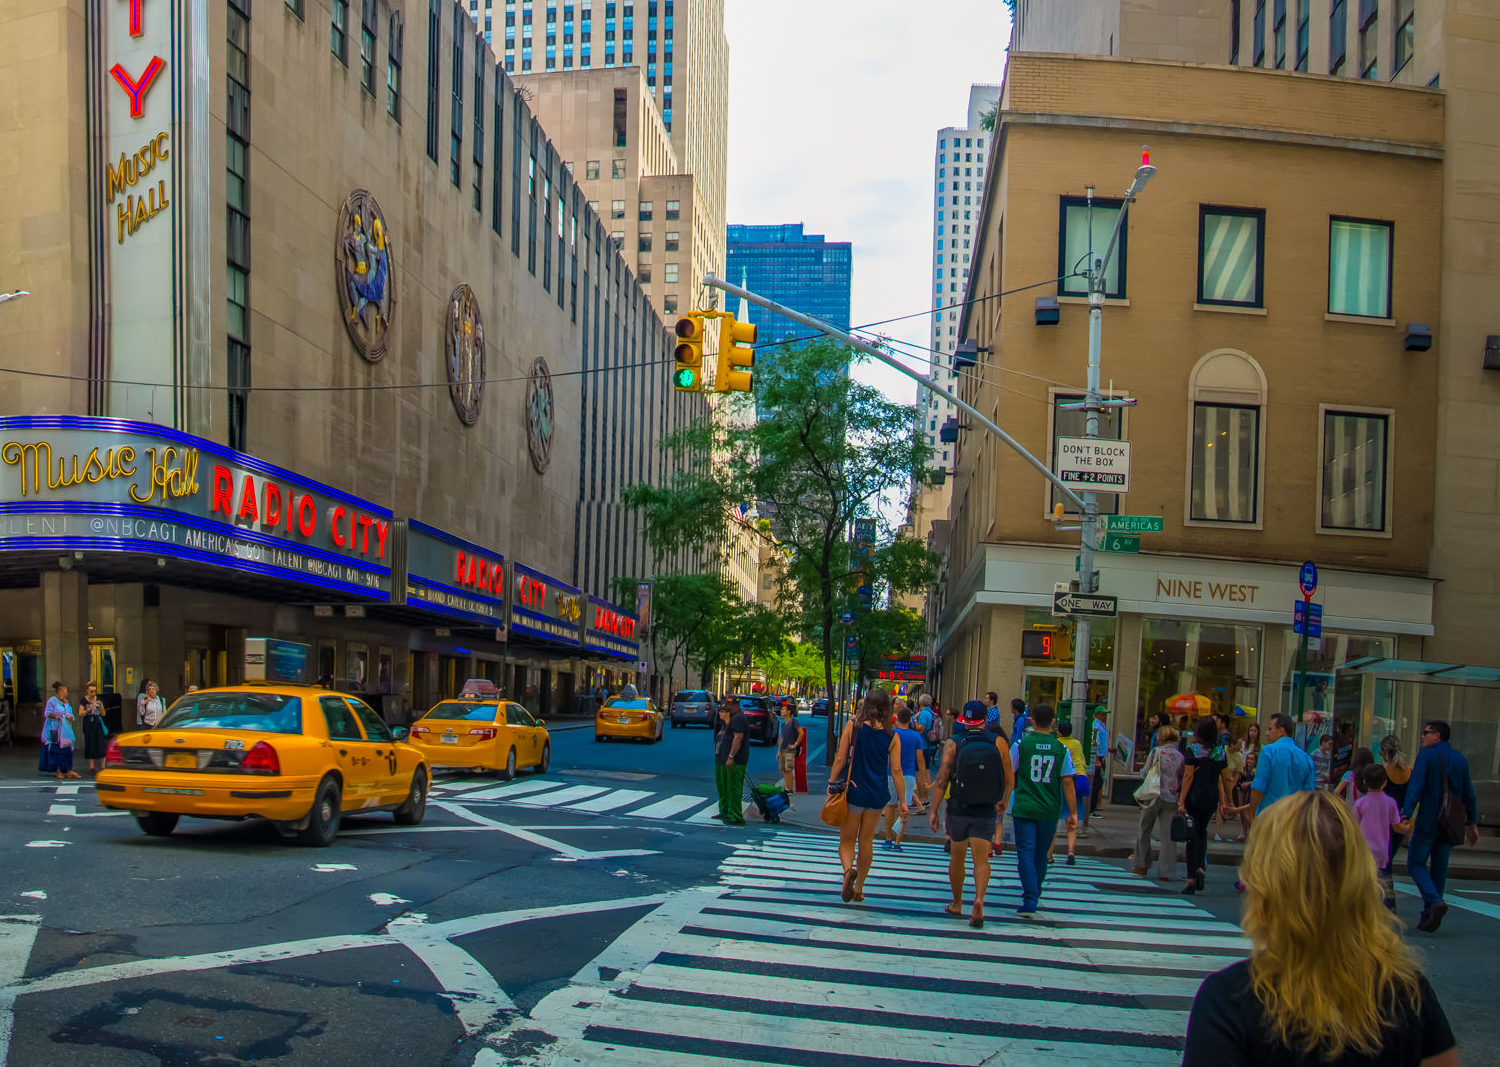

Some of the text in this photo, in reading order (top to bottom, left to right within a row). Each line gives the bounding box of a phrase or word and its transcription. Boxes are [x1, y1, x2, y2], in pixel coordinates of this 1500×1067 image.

[108, 132, 170, 204] MUSIC
[117, 179, 170, 245] HALL
[1063, 444, 1125, 457] DON'T BLOCK
[1074, 456, 1114, 467] THE BOX
[1, 440, 136, 496] Music
[130, 447, 200, 502] Hall
[1063, 471, 1123, 483] FINE +2 POINTS
[213, 464, 389, 559] RADIO CITY
[89, 517, 178, 542] @NBCAGT
[1111, 520, 1160, 531] AMERICAS
[1113, 539, 1121, 550] 6
[185, 528, 240, 558] AMERICA'S
[246, 544, 266, 561] GOT
[272, 549, 304, 570] TALENT
[307, 559, 343, 579] @NBCAGT
[365, 572, 380, 588] 9/16
[456, 550, 503, 595] RADIO
[520, 575, 547, 610] CITY
[1061, 598, 1113, 610] ONE WAY
[1157, 578, 1259, 604] NINE WEST
[595, 605, 619, 635] RADIO
[620, 615, 636, 639] CITY
[1042, 636, 1051, 656] 9
[879, 670, 905, 680] NBC
[1030, 754, 1055, 783] 87
